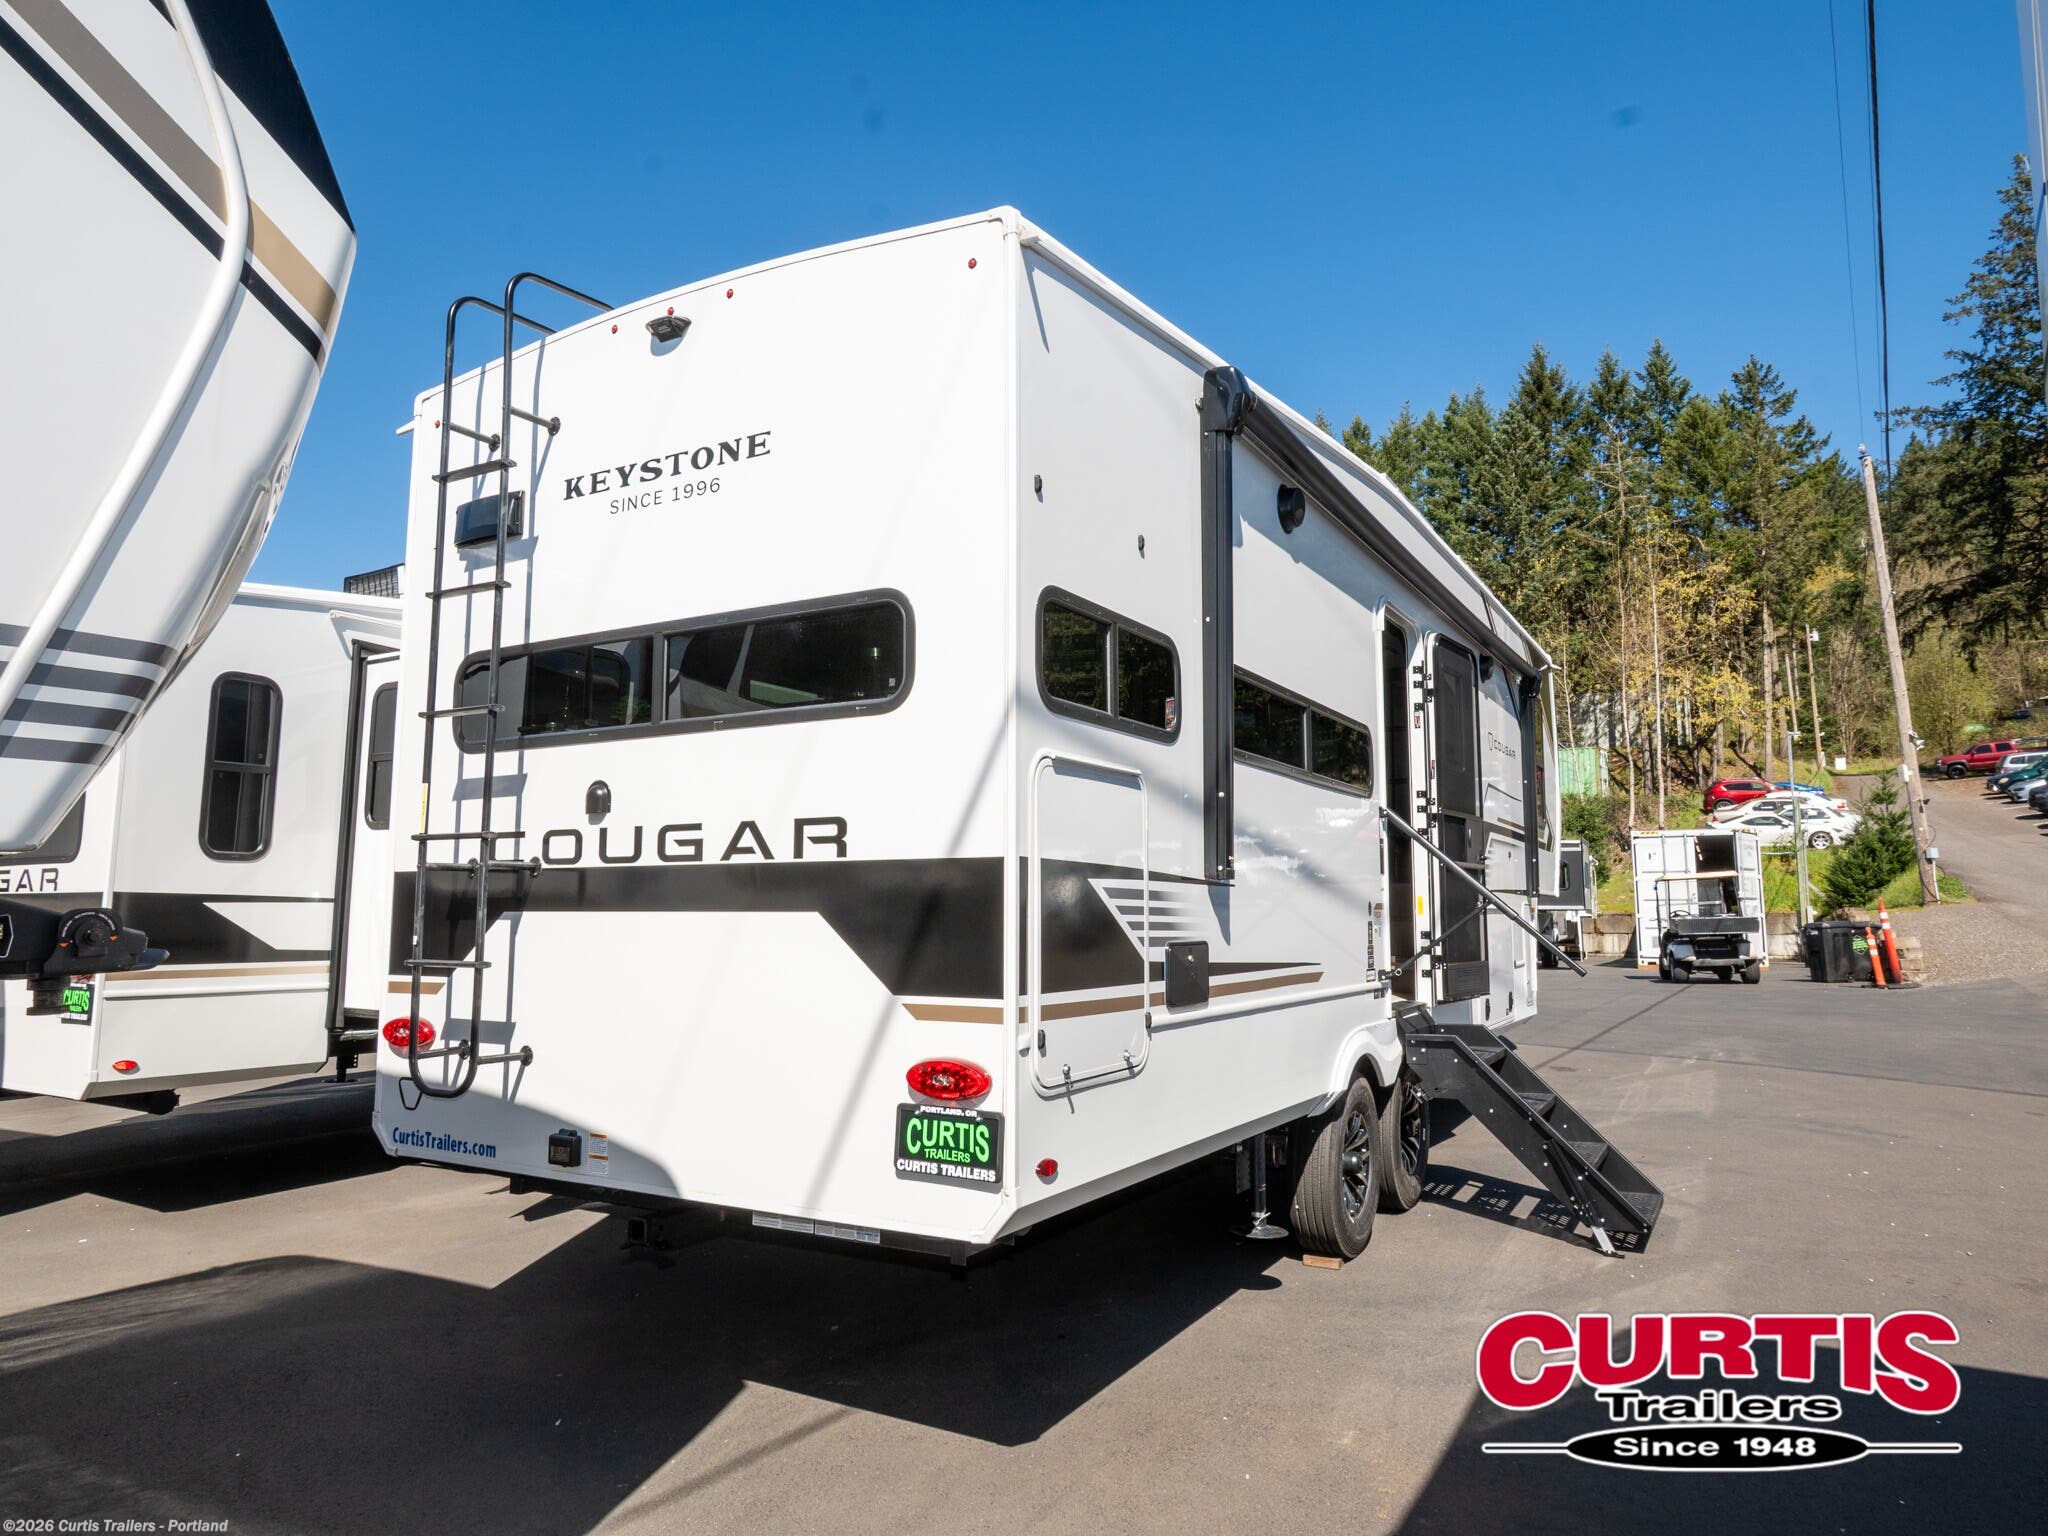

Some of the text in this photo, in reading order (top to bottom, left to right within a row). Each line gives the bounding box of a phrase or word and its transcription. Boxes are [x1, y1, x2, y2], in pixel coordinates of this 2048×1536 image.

[563, 430, 771, 500] KEYSTONE
[609, 477, 721, 515] SINCE 1996
[1493, 739, 1516, 760] COUGAR
[965, 1110, 978, 1118] OR
[392, 1126, 497, 1158] CurtisTrailers.com
[906, 1117, 990, 1163] CURTIS
[924, 1148, 971, 1163] TRAILERS
[896, 1158, 997, 1182] CURTIS TRAILERS
